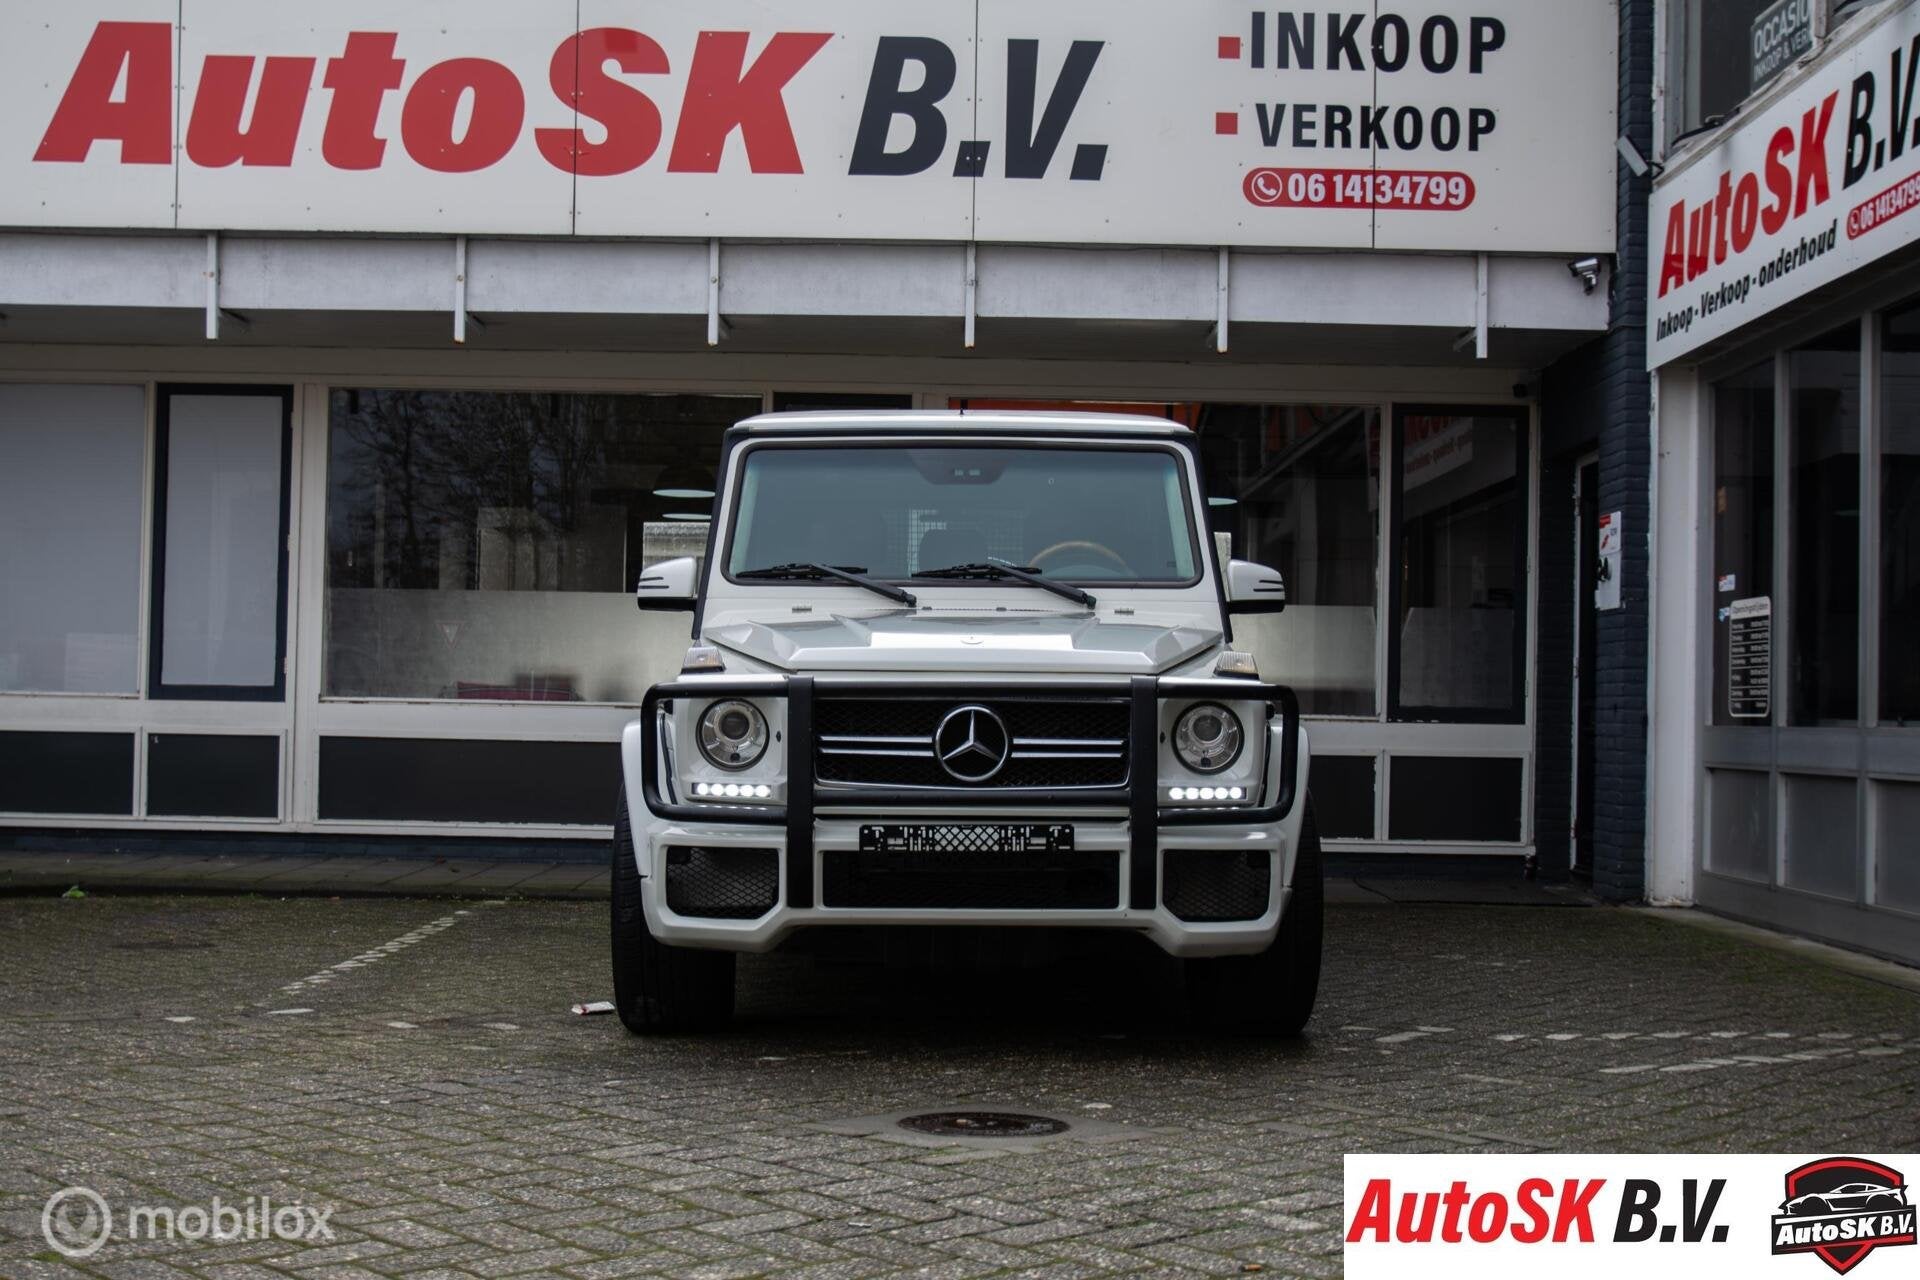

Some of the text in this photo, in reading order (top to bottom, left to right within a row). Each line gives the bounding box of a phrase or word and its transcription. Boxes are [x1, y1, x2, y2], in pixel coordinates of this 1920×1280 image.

[1251, 11, 1506, 74] INKOOP
[32, 21, 1109, 181] AutoSK B.V.
[1255, 103, 1497, 152] VERKOOP
[1288, 173, 1467, 206] 06 14134799
[1658, 89, 1840, 299] AutoSK
[1860, 201, 1875, 230] 06
[1656, 305, 1693, 342] Inkoop
[1701, 274, 1750, 319] Verkoop
[1759, 218, 1838, 288] onderhoud
